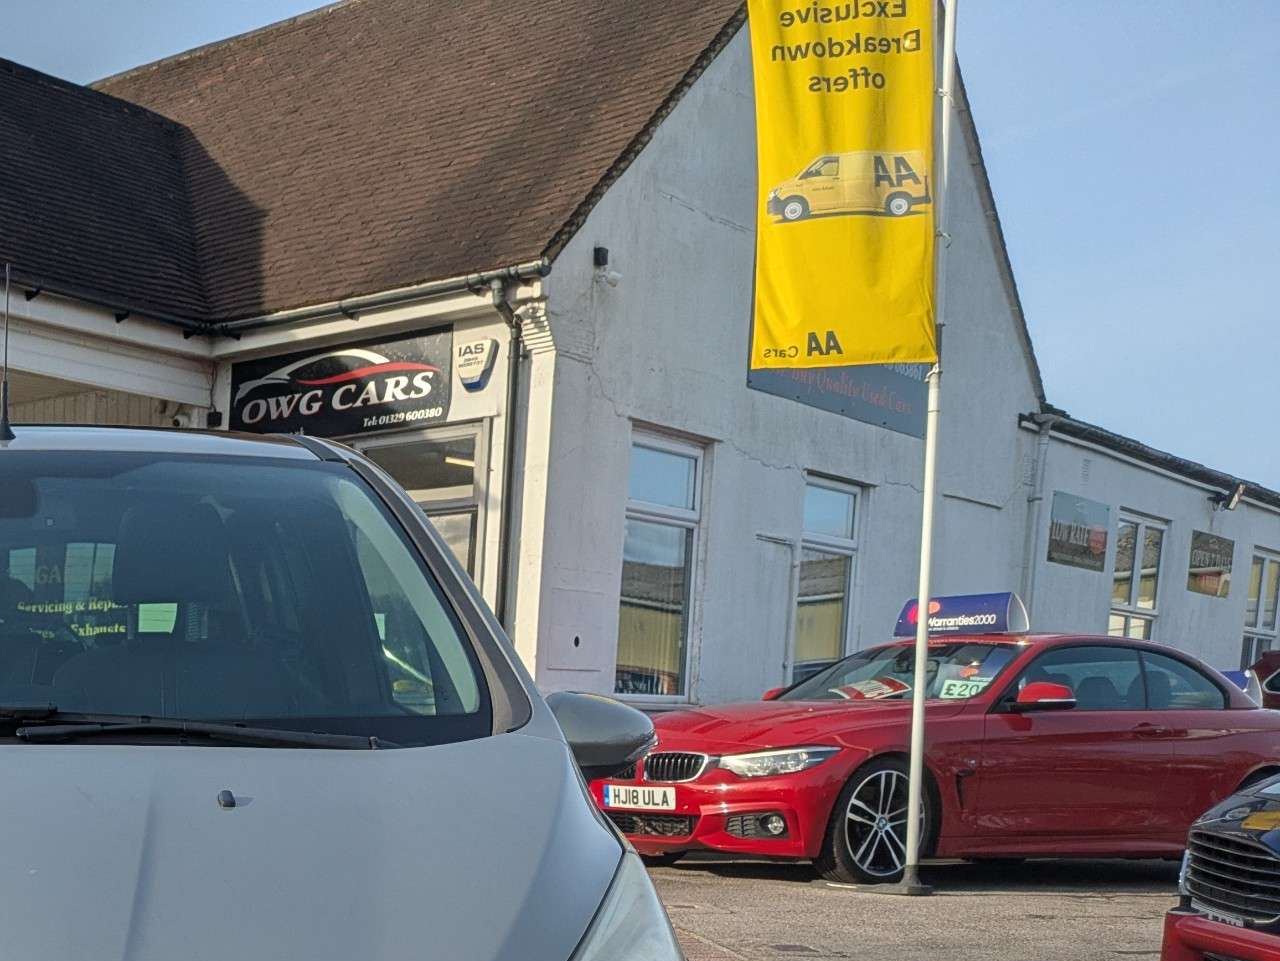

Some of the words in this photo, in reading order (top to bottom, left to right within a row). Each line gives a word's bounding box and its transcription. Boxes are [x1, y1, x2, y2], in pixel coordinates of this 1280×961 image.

[459, 343, 485, 357] IAS
[241, 389, 323, 424] OWG
[331, 371, 434, 411] CARS
[379, 413, 404, 425] 01329
[405, 407, 443, 421] 600380
[76, 601, 85, 610] &
[613, 788, 639, 804] HJ18
[642, 789, 669, 806] ULA
